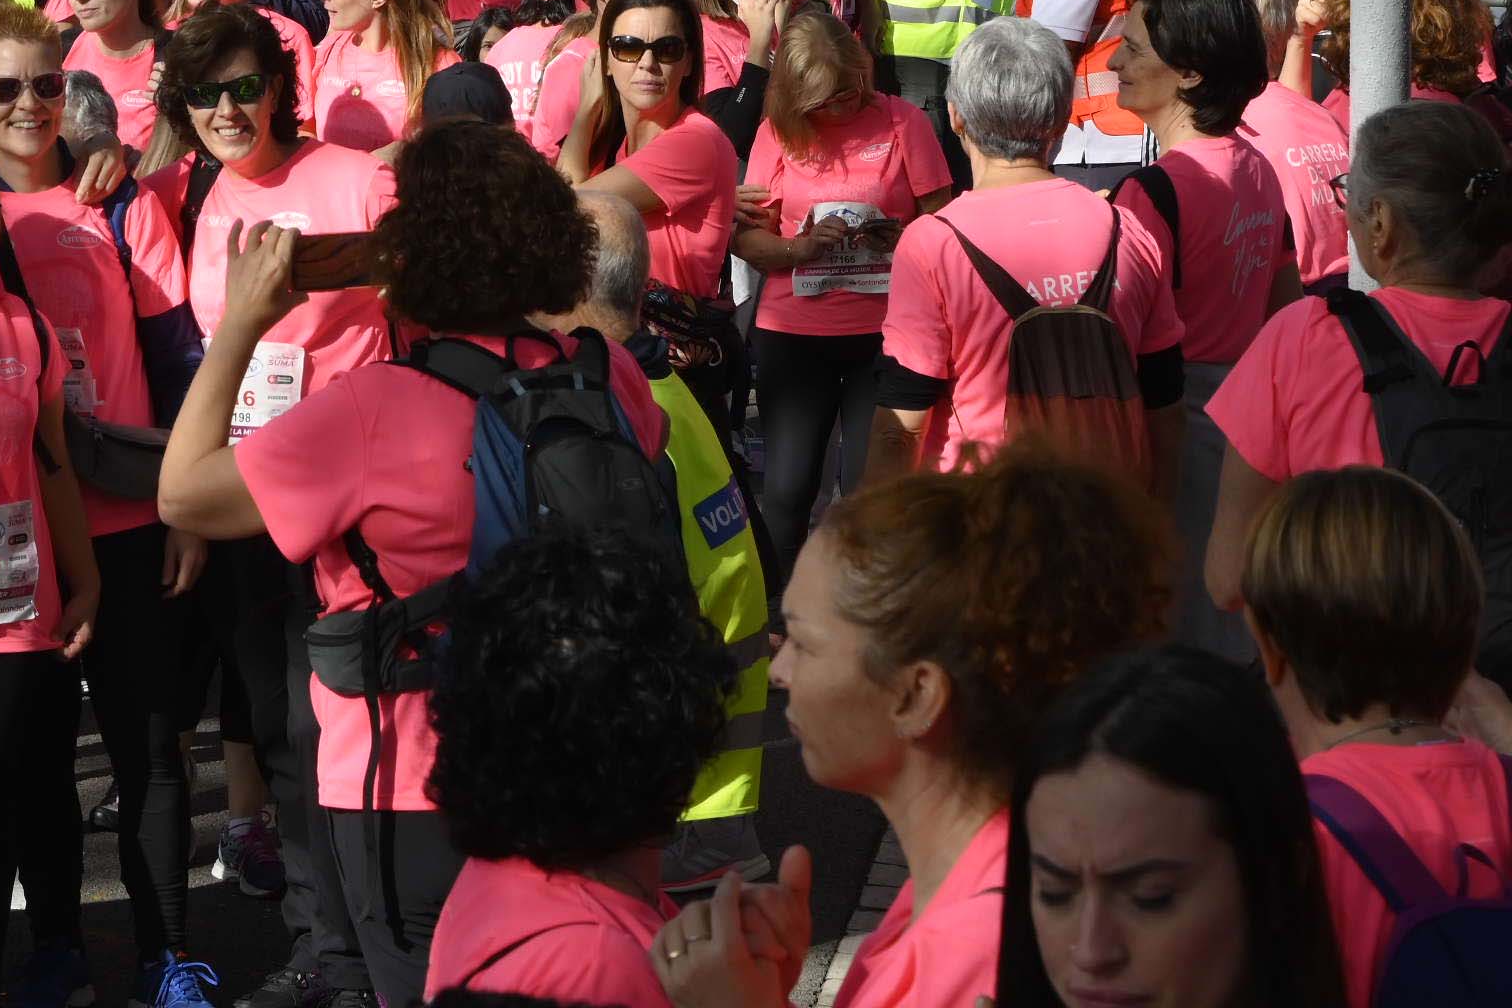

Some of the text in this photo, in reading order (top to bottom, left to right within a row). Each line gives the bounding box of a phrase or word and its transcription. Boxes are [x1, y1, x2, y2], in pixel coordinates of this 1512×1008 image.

[1286, 143, 1350, 167] CARRERA
[1311, 187, 1334, 207] MU
[268, 359, 294, 367] SUMA
[232, 412, 251, 423] 198
